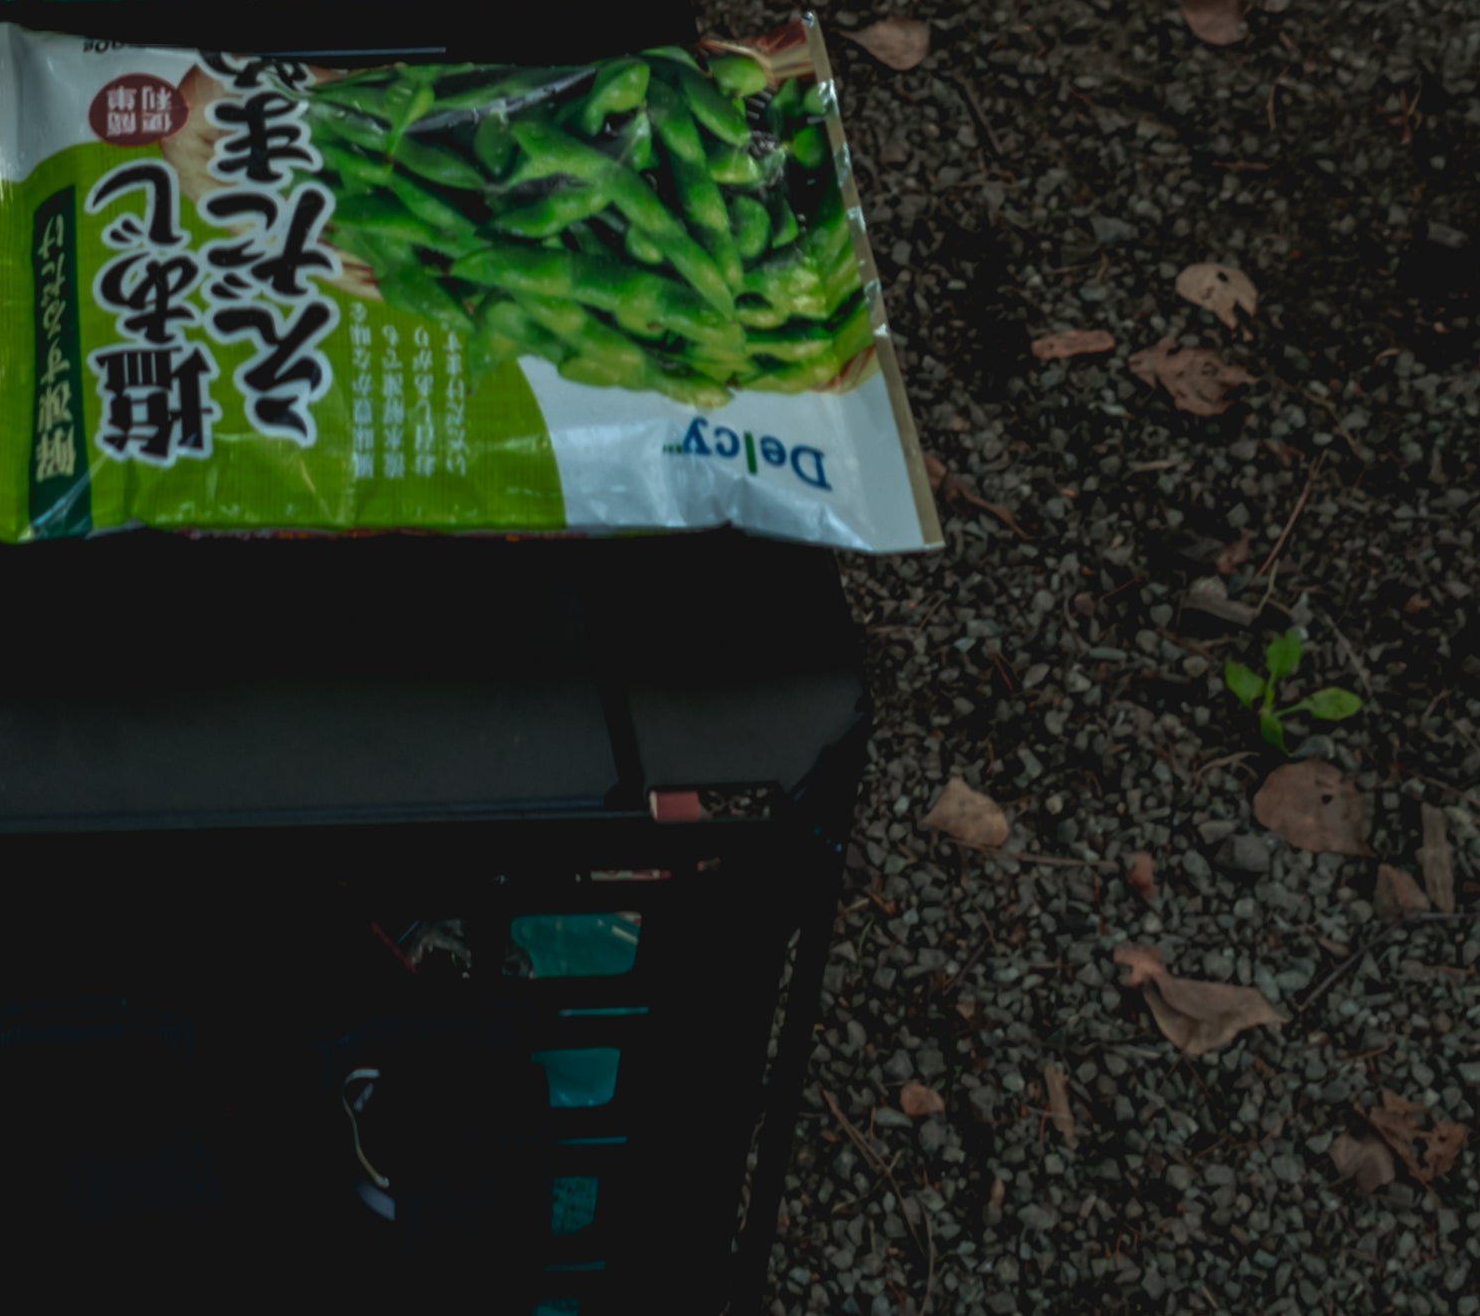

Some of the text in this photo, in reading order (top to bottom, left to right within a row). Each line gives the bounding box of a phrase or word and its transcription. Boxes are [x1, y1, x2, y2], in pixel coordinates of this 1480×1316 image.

[141, 85, 173, 137] 便利
[35, 213, 76, 484] 解凍するだけ
[89, 164, 214, 460] 塩あじ
[683, 416, 833, 492] Delcy
